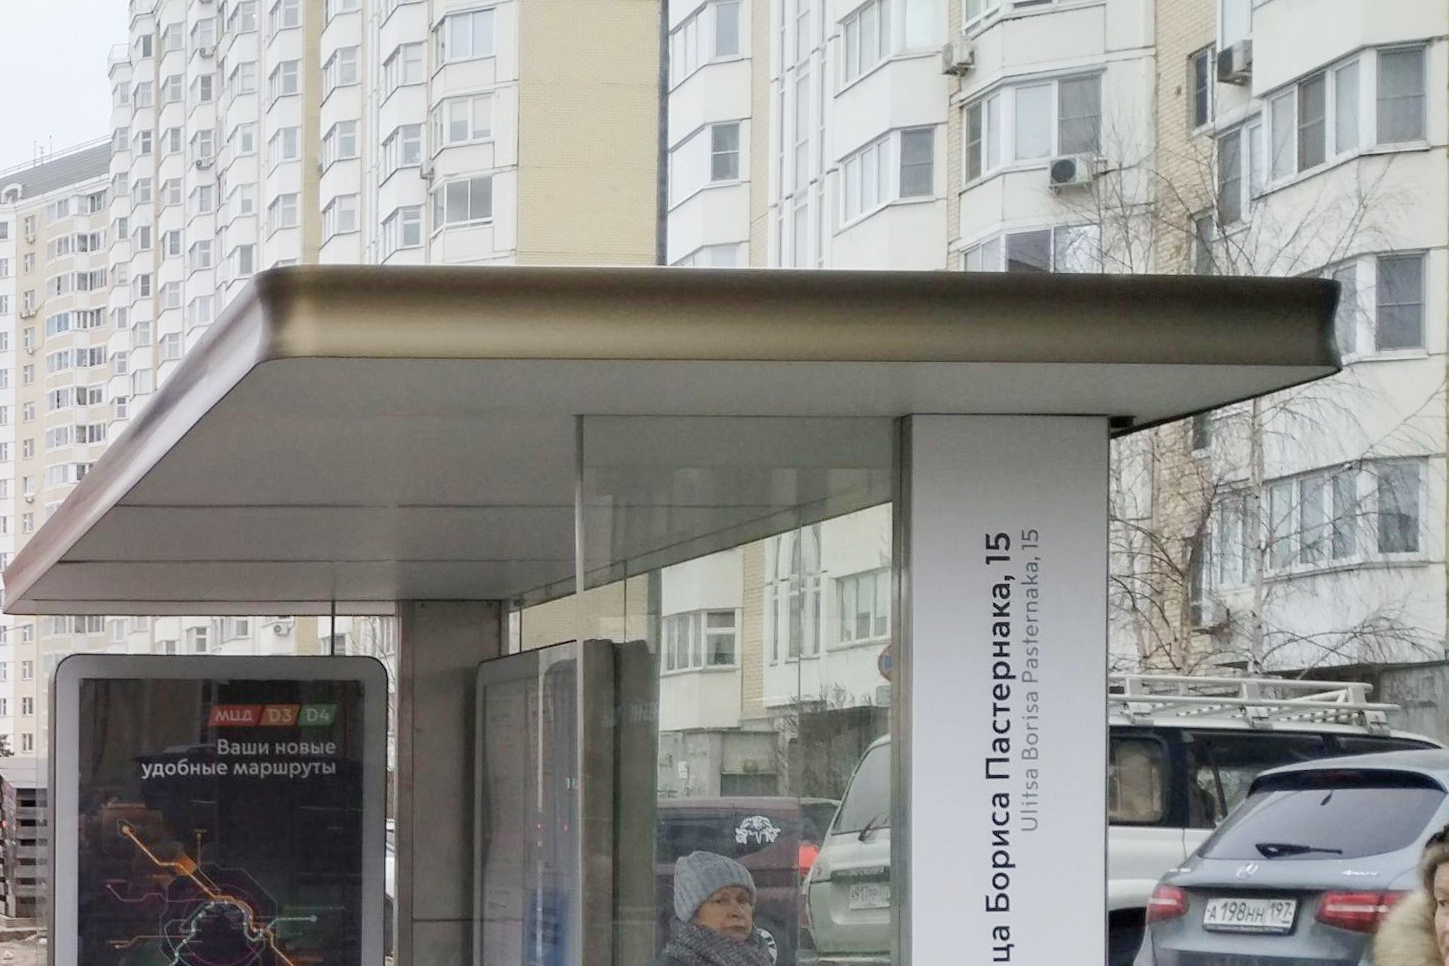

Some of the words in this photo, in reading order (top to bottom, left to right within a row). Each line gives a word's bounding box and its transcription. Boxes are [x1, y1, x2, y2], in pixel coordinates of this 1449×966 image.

[985, 531, 1011, 565] 15
[1020, 528, 1039, 550] 15
[1020, 556, 1042, 683] Pasternaka,
[985, 574, 1017, 780] Пастернака,
[214, 707, 254, 723] МЦД
[268, 707, 293, 723] D3
[305, 707, 330, 722] D4
[1020, 691, 1039, 761] Borisa
[141, 758, 228, 780] удобные
[233, 761, 337, 779] маршруты
[216, 738, 269, 756] Ваши
[275, 740, 337, 756] новые
[1020, 768, 1039, 832] Ulitsa
[985, 792, 1017, 913] Бориса
